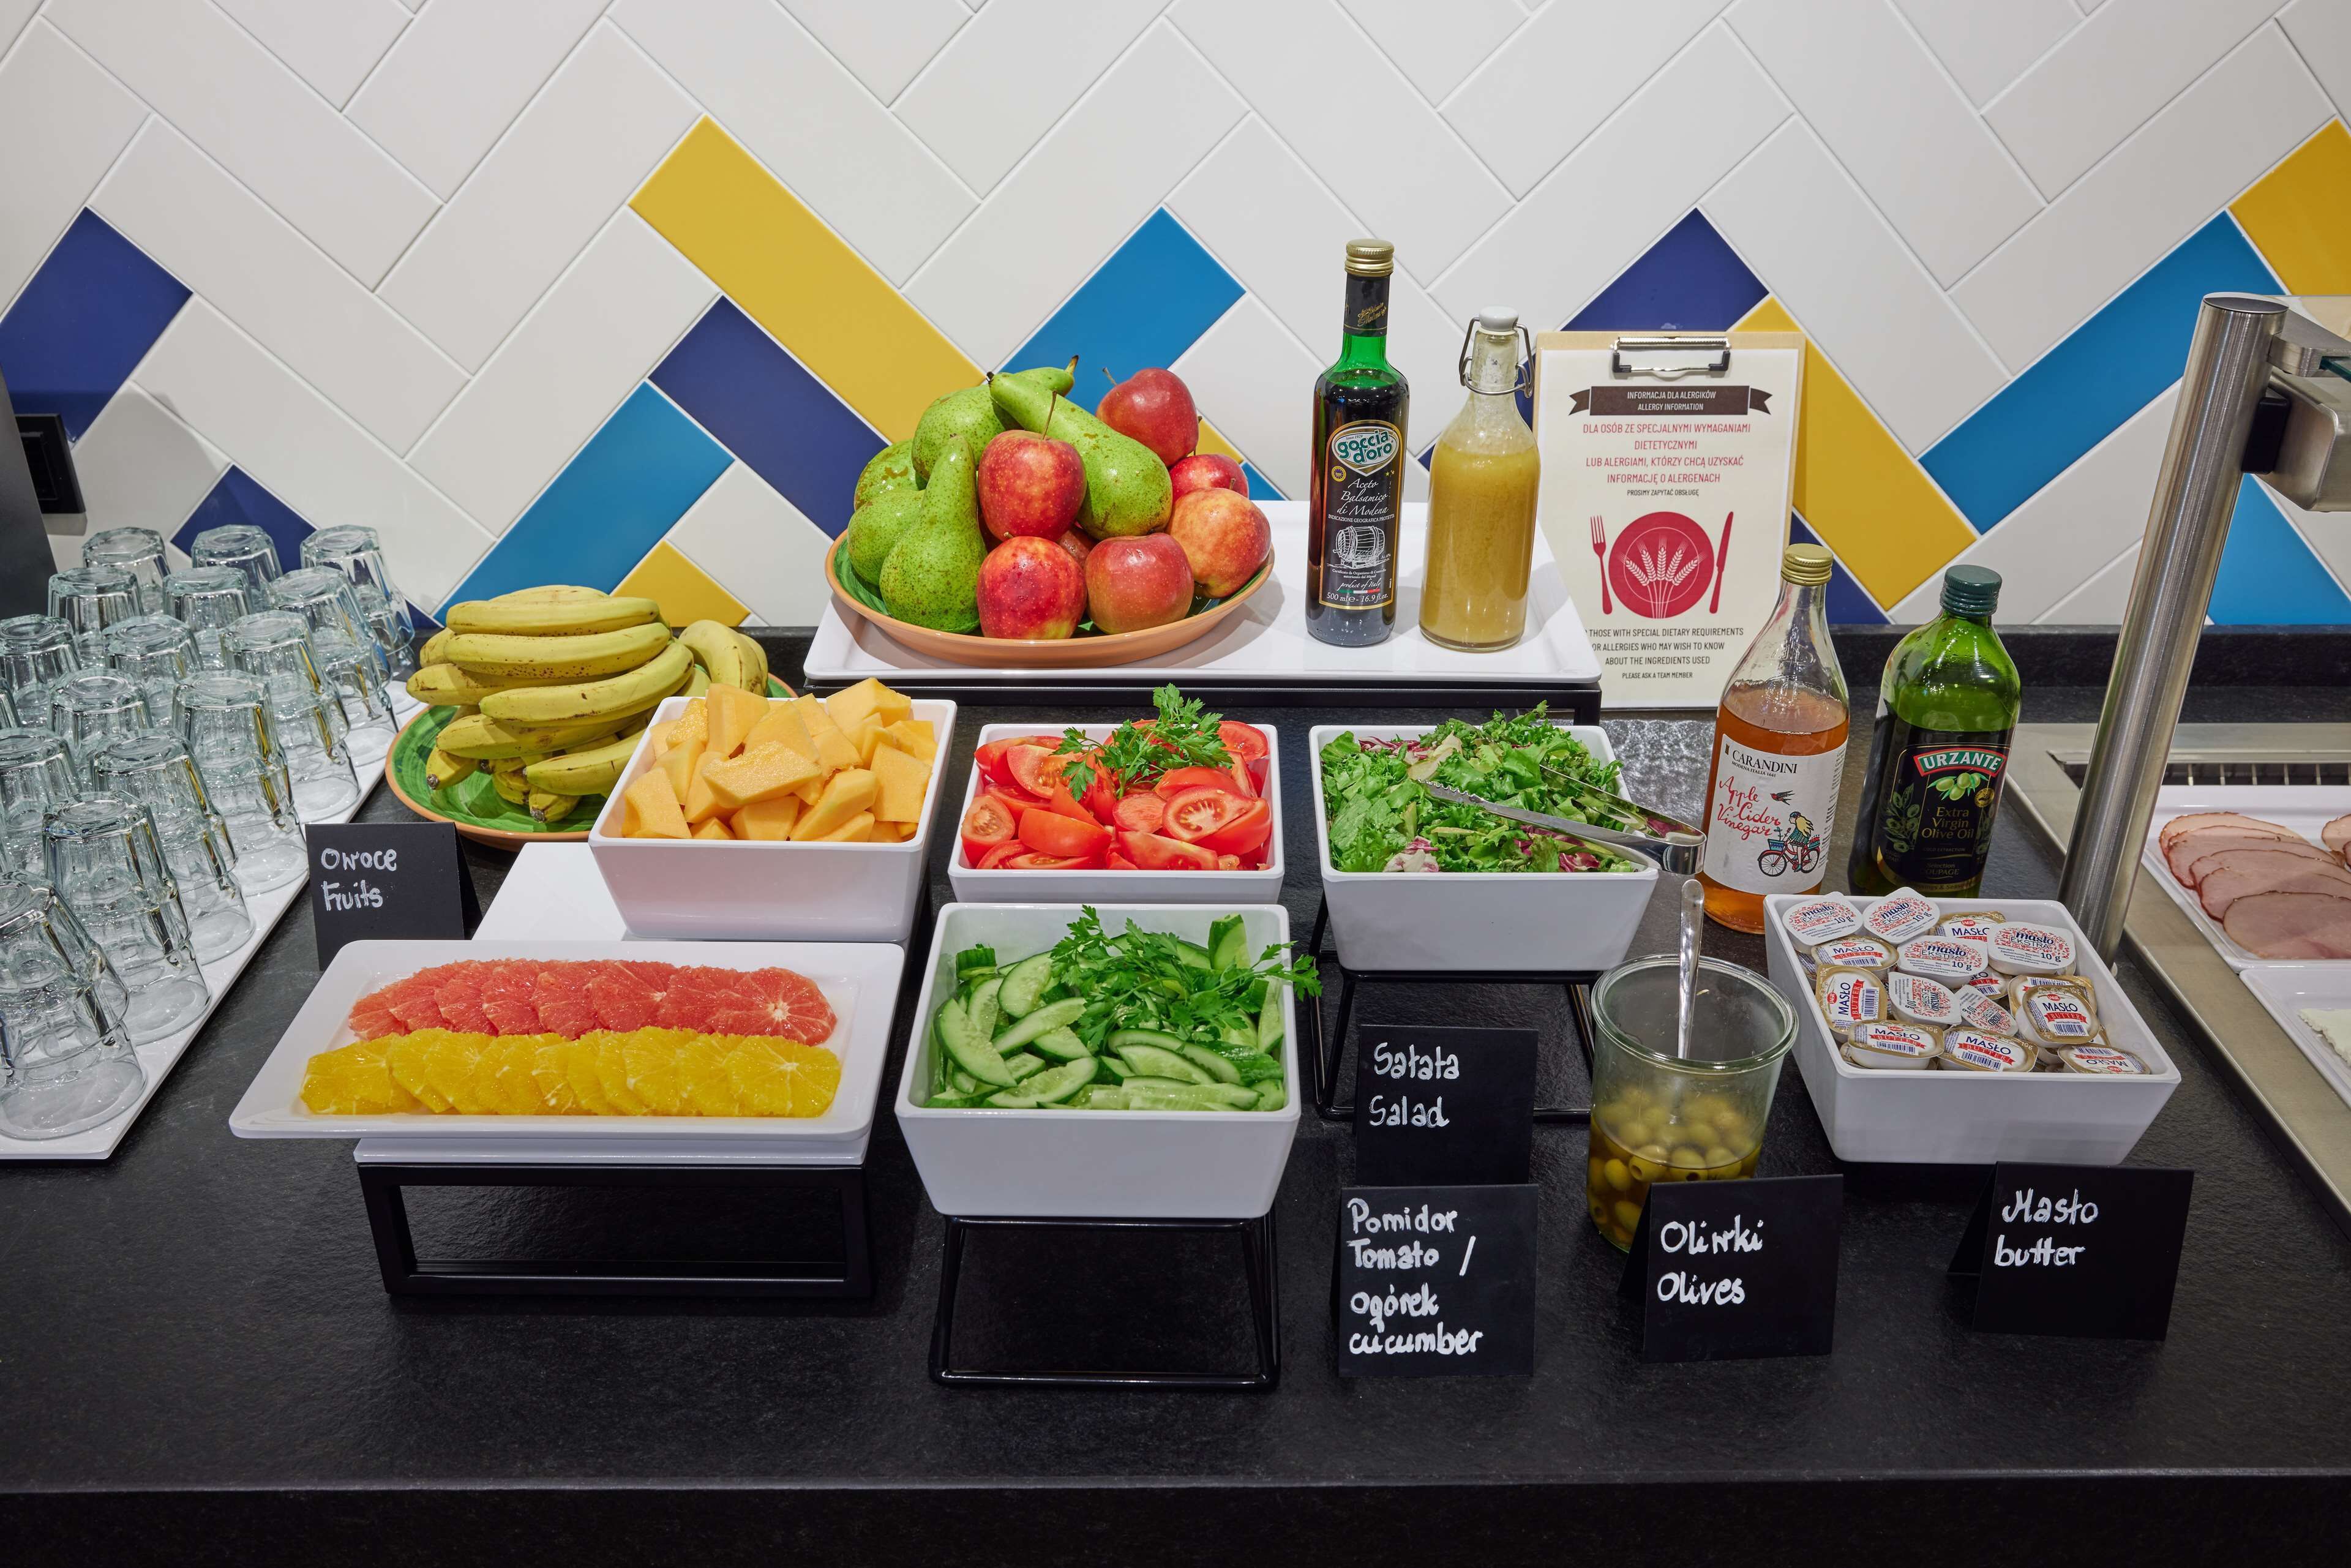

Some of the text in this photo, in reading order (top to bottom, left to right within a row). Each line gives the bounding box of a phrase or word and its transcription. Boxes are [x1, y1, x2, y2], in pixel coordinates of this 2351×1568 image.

[1680, 389, 1716, 399] ALERGIKÓW
[1583, 422, 1750, 433] DLA OSÓB ZE SPECJALNYMI WYMAGANIAMI
[1337, 429, 1389, 459] goccia
[1634, 440, 1698, 450] DIETETYCZNYMI
[1353, 443, 1393, 464] d'oro
[1586, 456, 1744, 468] LUB ALERGIAMI, KTÓRZY CHCĄ UZYSKAĆ
[1348, 478, 1379, 489] Aceto
[1607, 473, 1720, 485] INFORMACJĘ O ALERGENACH
[1340, 489, 1389, 502] Balsamico
[1337, 500, 1389, 516] di Modena
[1328, 514, 1354, 523] INDICAZIONE
[1337, 580, 1360, 591] product
[1361, 578, 1372, 591] of
[1369, 577, 1382, 589] Italy
[1327, 592, 1339, 601] 500
[1589, 629, 1611, 637] THOSE
[1632, 628, 1660, 637] SPECIAL
[1662, 628, 1690, 637] DIETARY
[1692, 628, 1744, 636] REQUIREMENTS
[1592, 643, 1602, 651] OR
[1603, 642, 1639, 651] ALLERGIES
[1704, 642, 1725, 650] KNOW
[1732, 760, 1750, 772] MODENA
[1733, 750, 1798, 774] CARANDINI
[1923, 752, 2001, 771] URZANTE
[1719, 776, 1760, 808] Apple
[1733, 801, 1781, 826] Cider
[1937, 807, 1970, 817] Extra
[1717, 803, 1772, 841] Vinegar
[1932, 817, 1969, 830] Virgin
[1921, 828, 1974, 839] Olive Oil
[321, 847, 397, 871] Owoce
[321, 879, 383, 911] Fruits
[1802, 905, 1834, 917] masło
[1802, 910, 1835, 923] EKSTRA
[1881, 902, 1910, 920] masło
[1882, 909, 1913, 926] EKSTRA
[2010, 937, 2050, 950] EKSTRA
[2015, 931, 2055, 945] masło
[1832, 945, 1874, 954] MASŁO
[1921, 950, 1963, 960] EKSTRA
[1927, 945, 1967, 956] masło
[1838, 982, 1851, 1016] MASŁO
[1852, 985, 1861, 1015] BUTTER
[1922, 989, 1930, 1008] EKSTRA
[1930, 992, 1944, 1013] masło
[2042, 1002, 2078, 1012] MASŁO
[1875, 1028, 1921, 1040] MASŁO
[1966, 1036, 2011, 1055] MASŁO
[1967, 1045, 2008, 1060] BUTTER
[1369, 1096, 1450, 1128] Salad
[1347, 1197, 1458, 1234] Pomidor
[1660, 1214, 1764, 1255] Oliwki
[1346, 1236, 1476, 1277] Tomato /
[1994, 1234, 2085, 1267] butter
[1657, 1271, 1745, 1305] Olives
[1350, 1283, 1439, 1334] ogórek
[1349, 1321, 1483, 1356] cucumber
